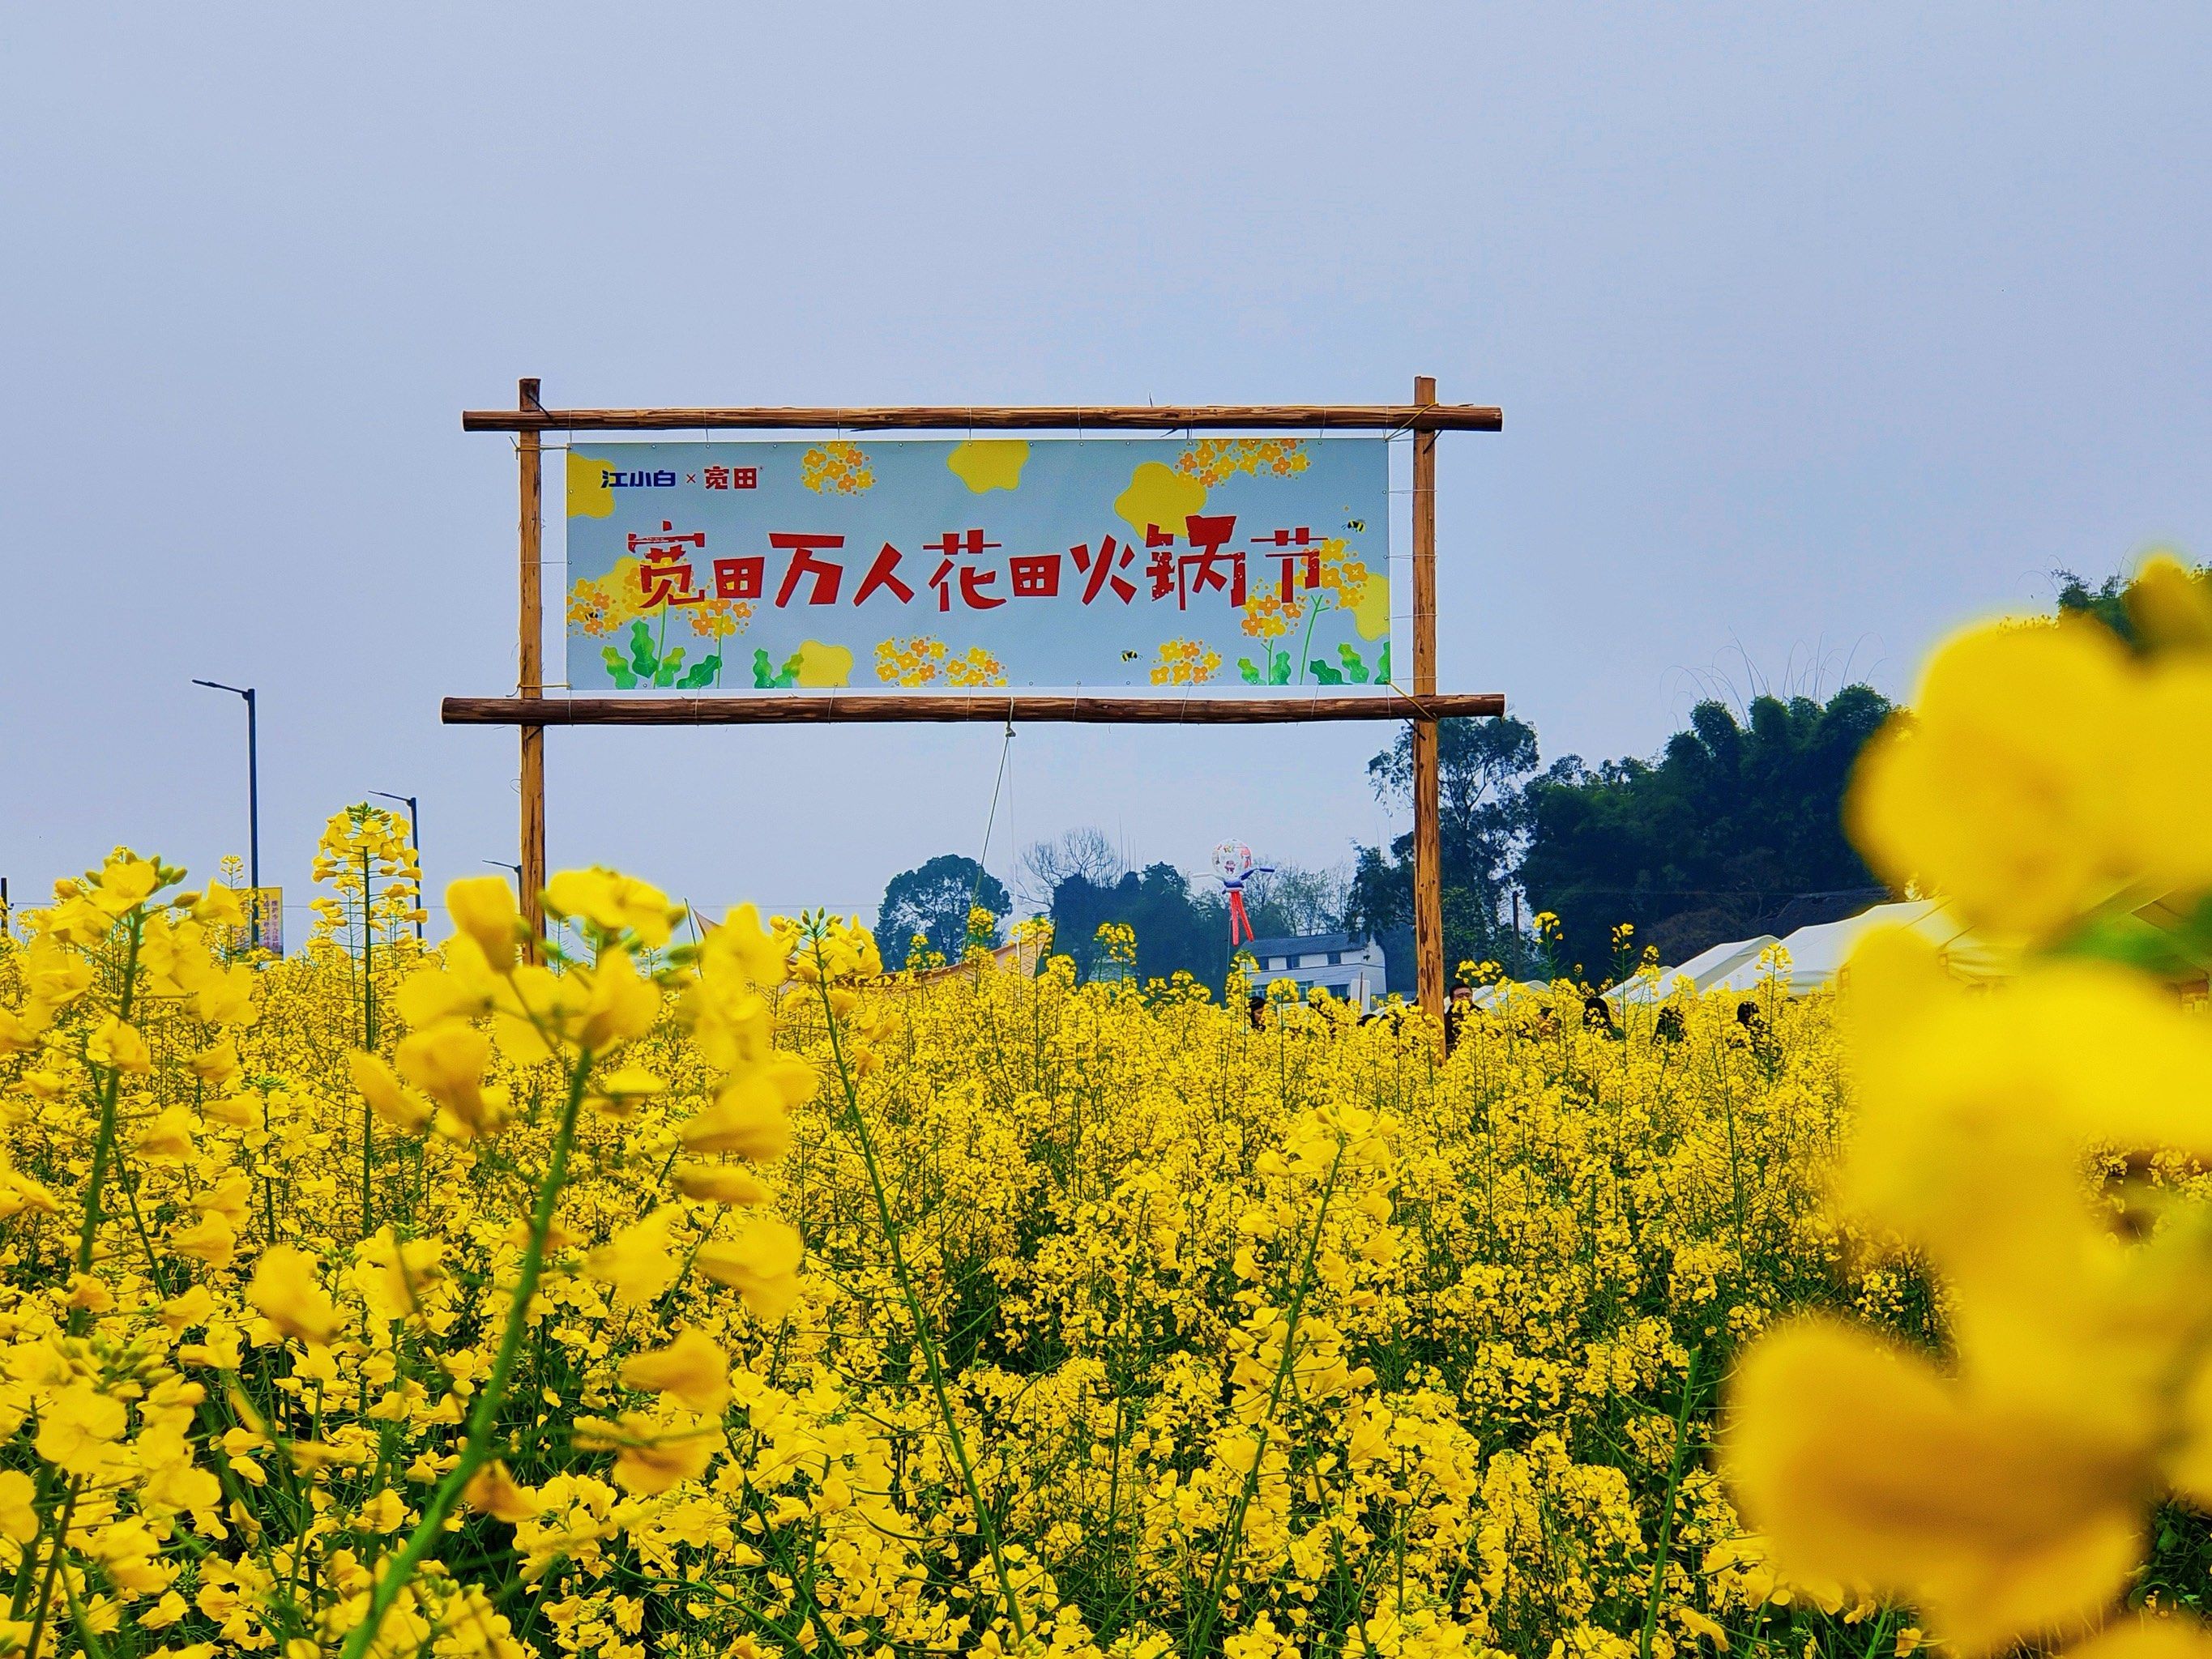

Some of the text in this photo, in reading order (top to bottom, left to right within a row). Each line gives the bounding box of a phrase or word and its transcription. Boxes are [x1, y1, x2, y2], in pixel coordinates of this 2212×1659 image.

[600, 469, 677, 488] 江小白
[704, 466, 758, 490] 宽田
[627, 514, 1329, 612] 宽田万人花田火锅节
